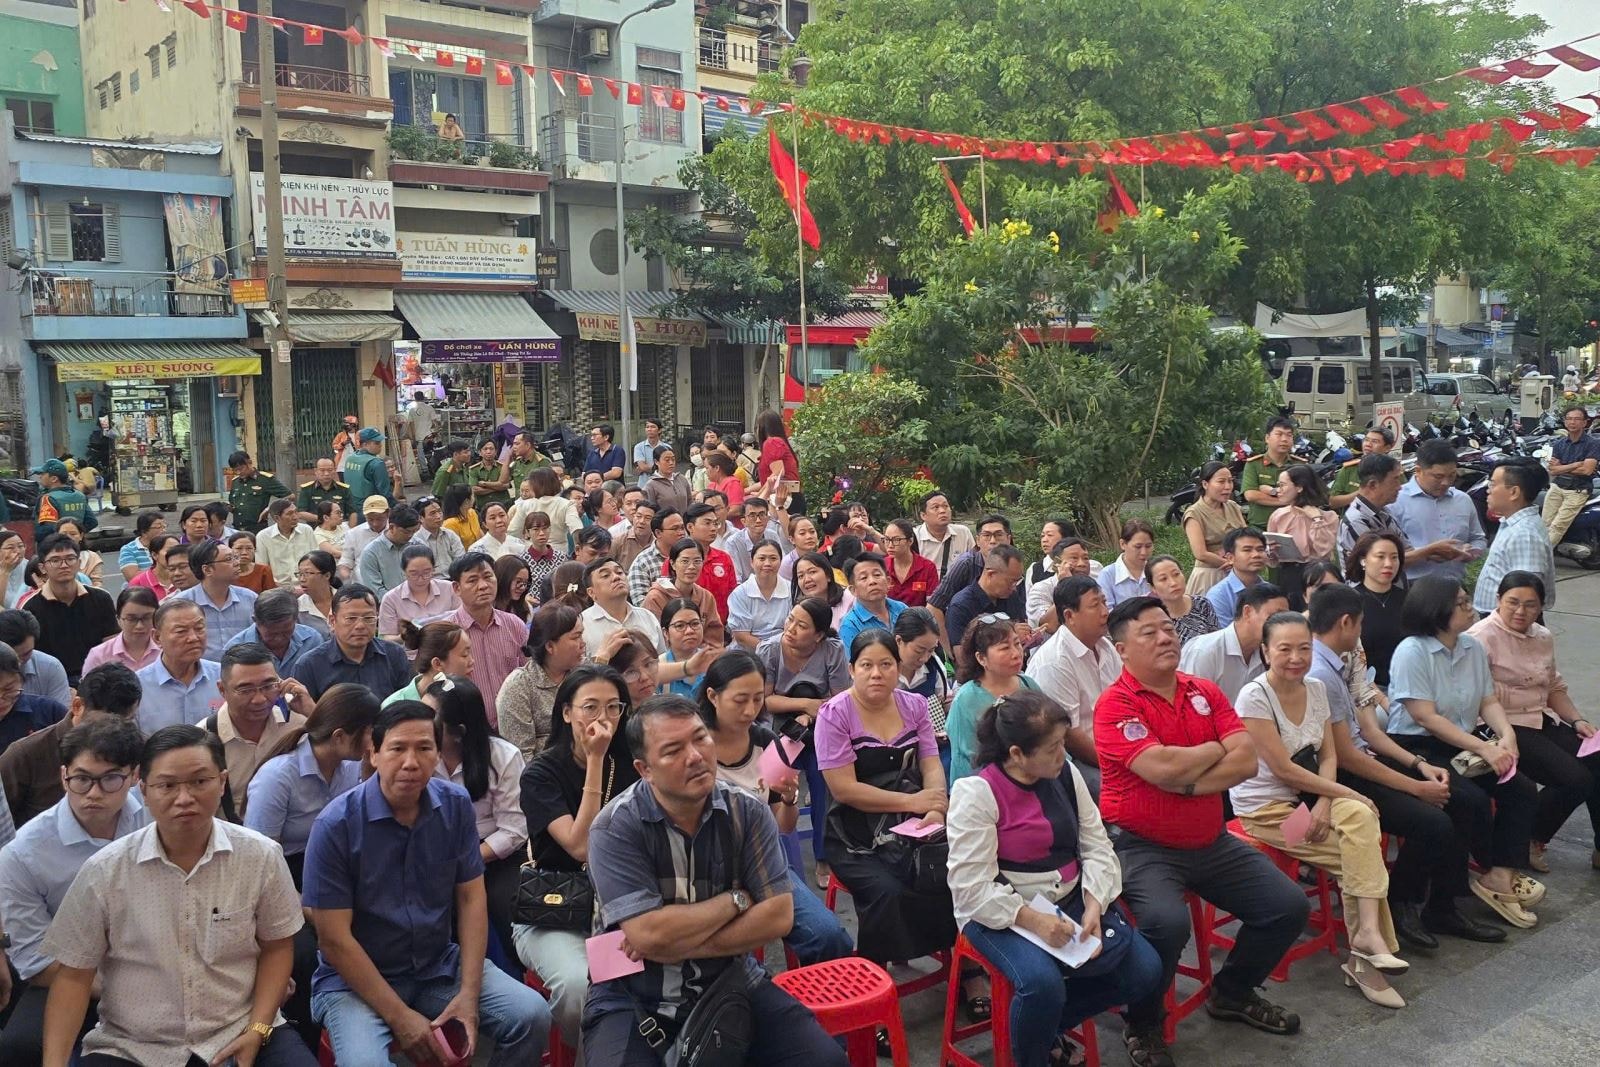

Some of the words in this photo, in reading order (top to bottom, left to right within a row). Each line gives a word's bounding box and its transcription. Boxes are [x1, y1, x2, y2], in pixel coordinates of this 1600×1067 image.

[280, 181, 301, 191] KIỆN
[303, 182, 319, 191] KHÍ
[321, 182, 340, 192] NÉN
[346, 184, 370, 194] THỦY
[372, 187, 389, 197] LỰC
[336, 194, 391, 220] TÂM
[411, 236, 459, 252] TUẤN
[464, 238, 511, 255] HÙNG
[579, 315, 600, 329] KHÍ
[603, 317, 619, 330] NÉ
[524, 341, 557, 350] HÙNG
[114, 362, 156, 375] KIỀU
[161, 361, 215, 373] SƯƠNG
